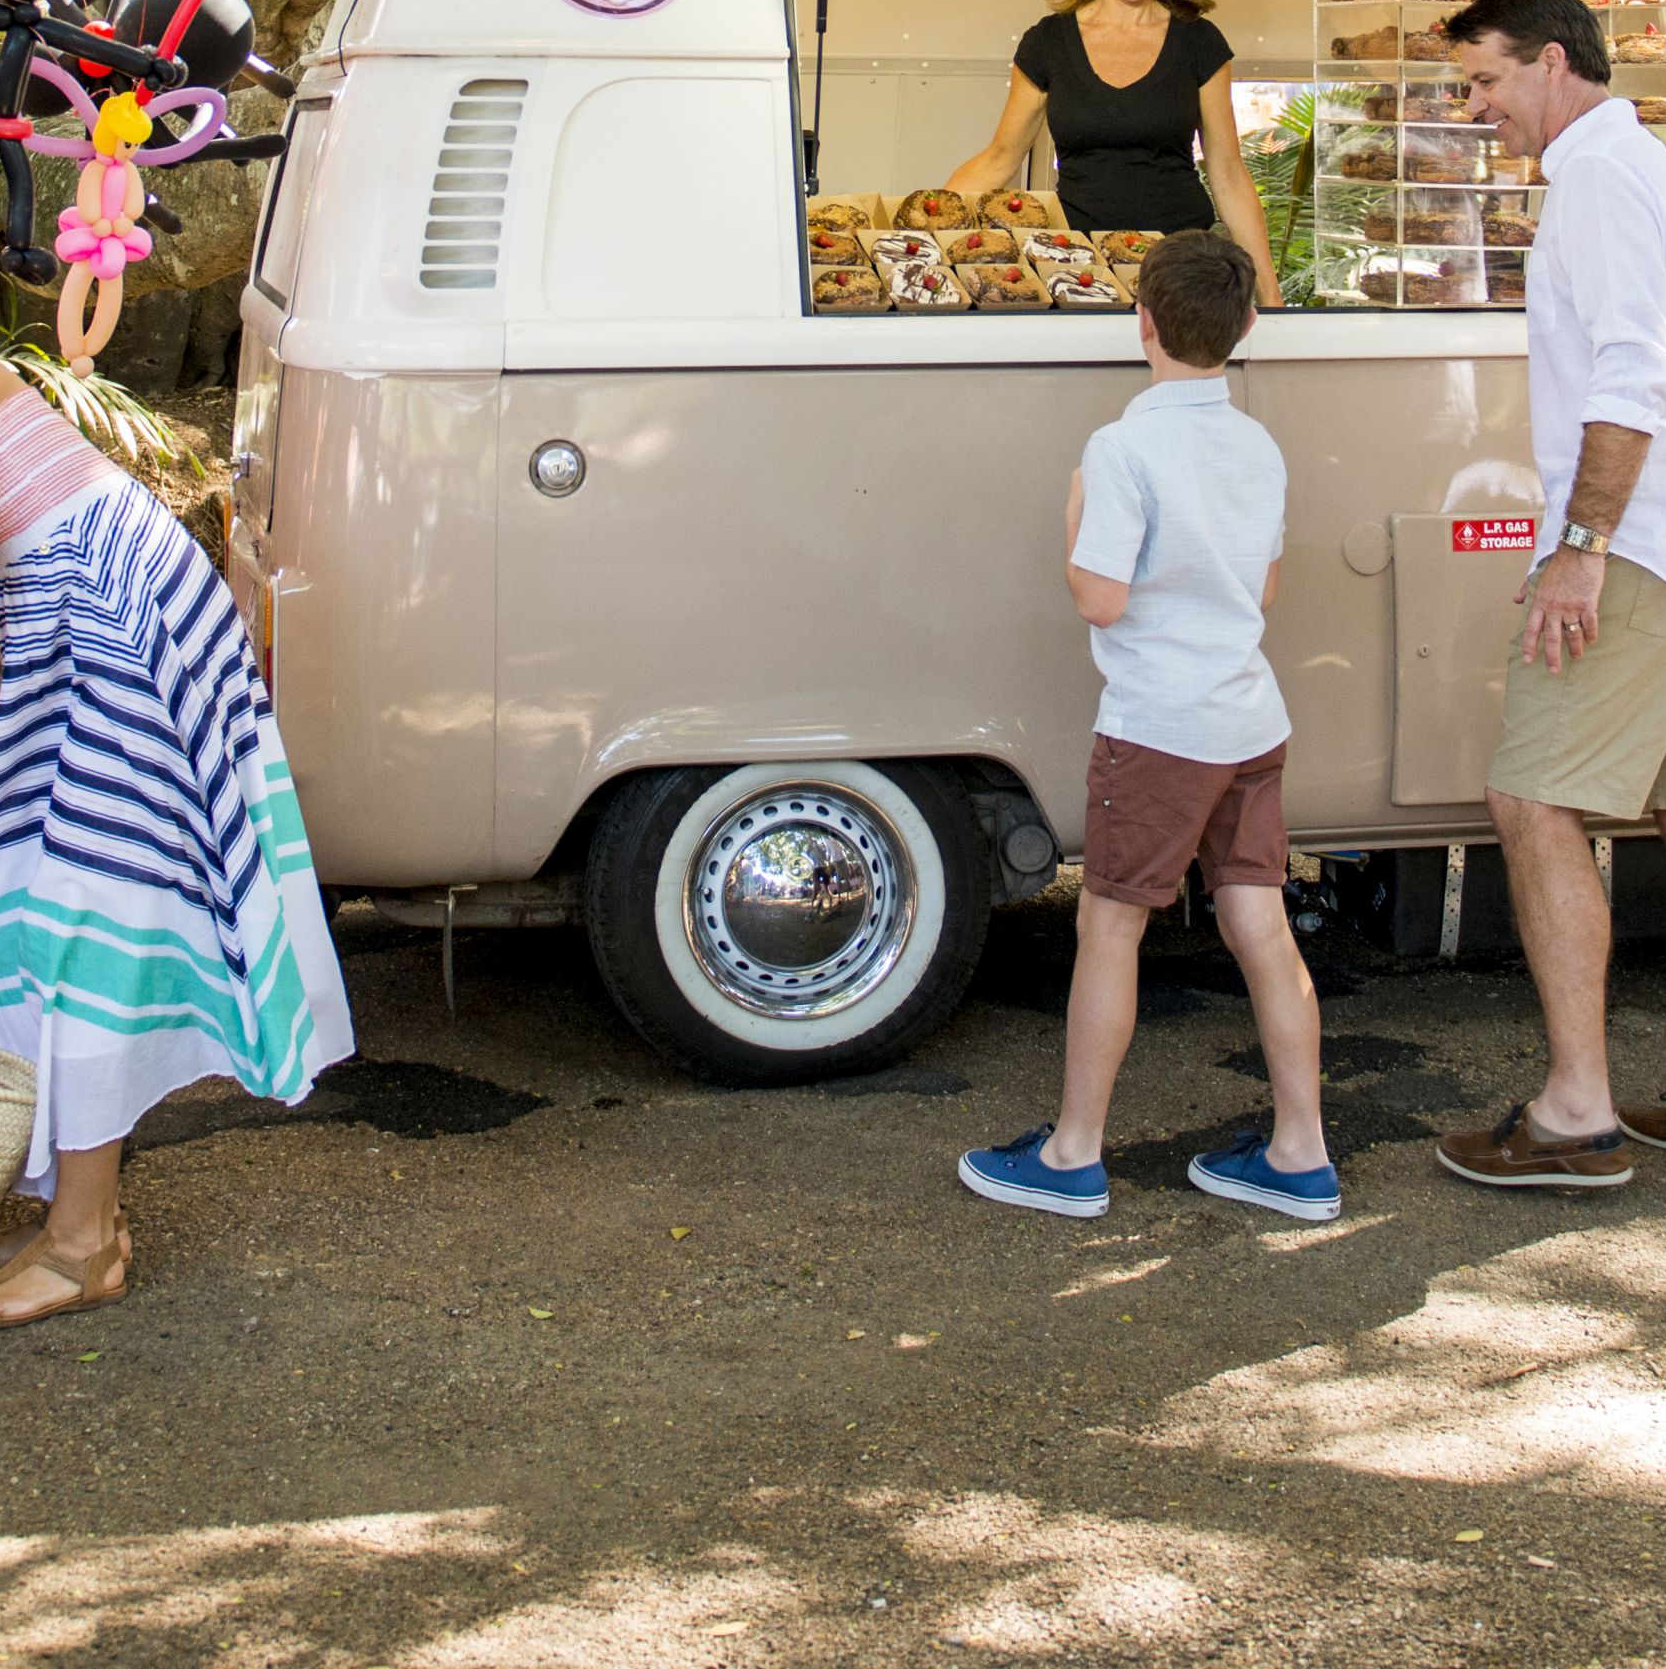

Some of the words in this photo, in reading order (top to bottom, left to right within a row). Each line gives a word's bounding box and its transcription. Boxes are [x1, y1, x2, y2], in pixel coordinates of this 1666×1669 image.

[1483, 522, 1504, 534] L.P.
[1505, 521, 1530, 533] GAS
[1480, 536, 1533, 549] STORAGE
